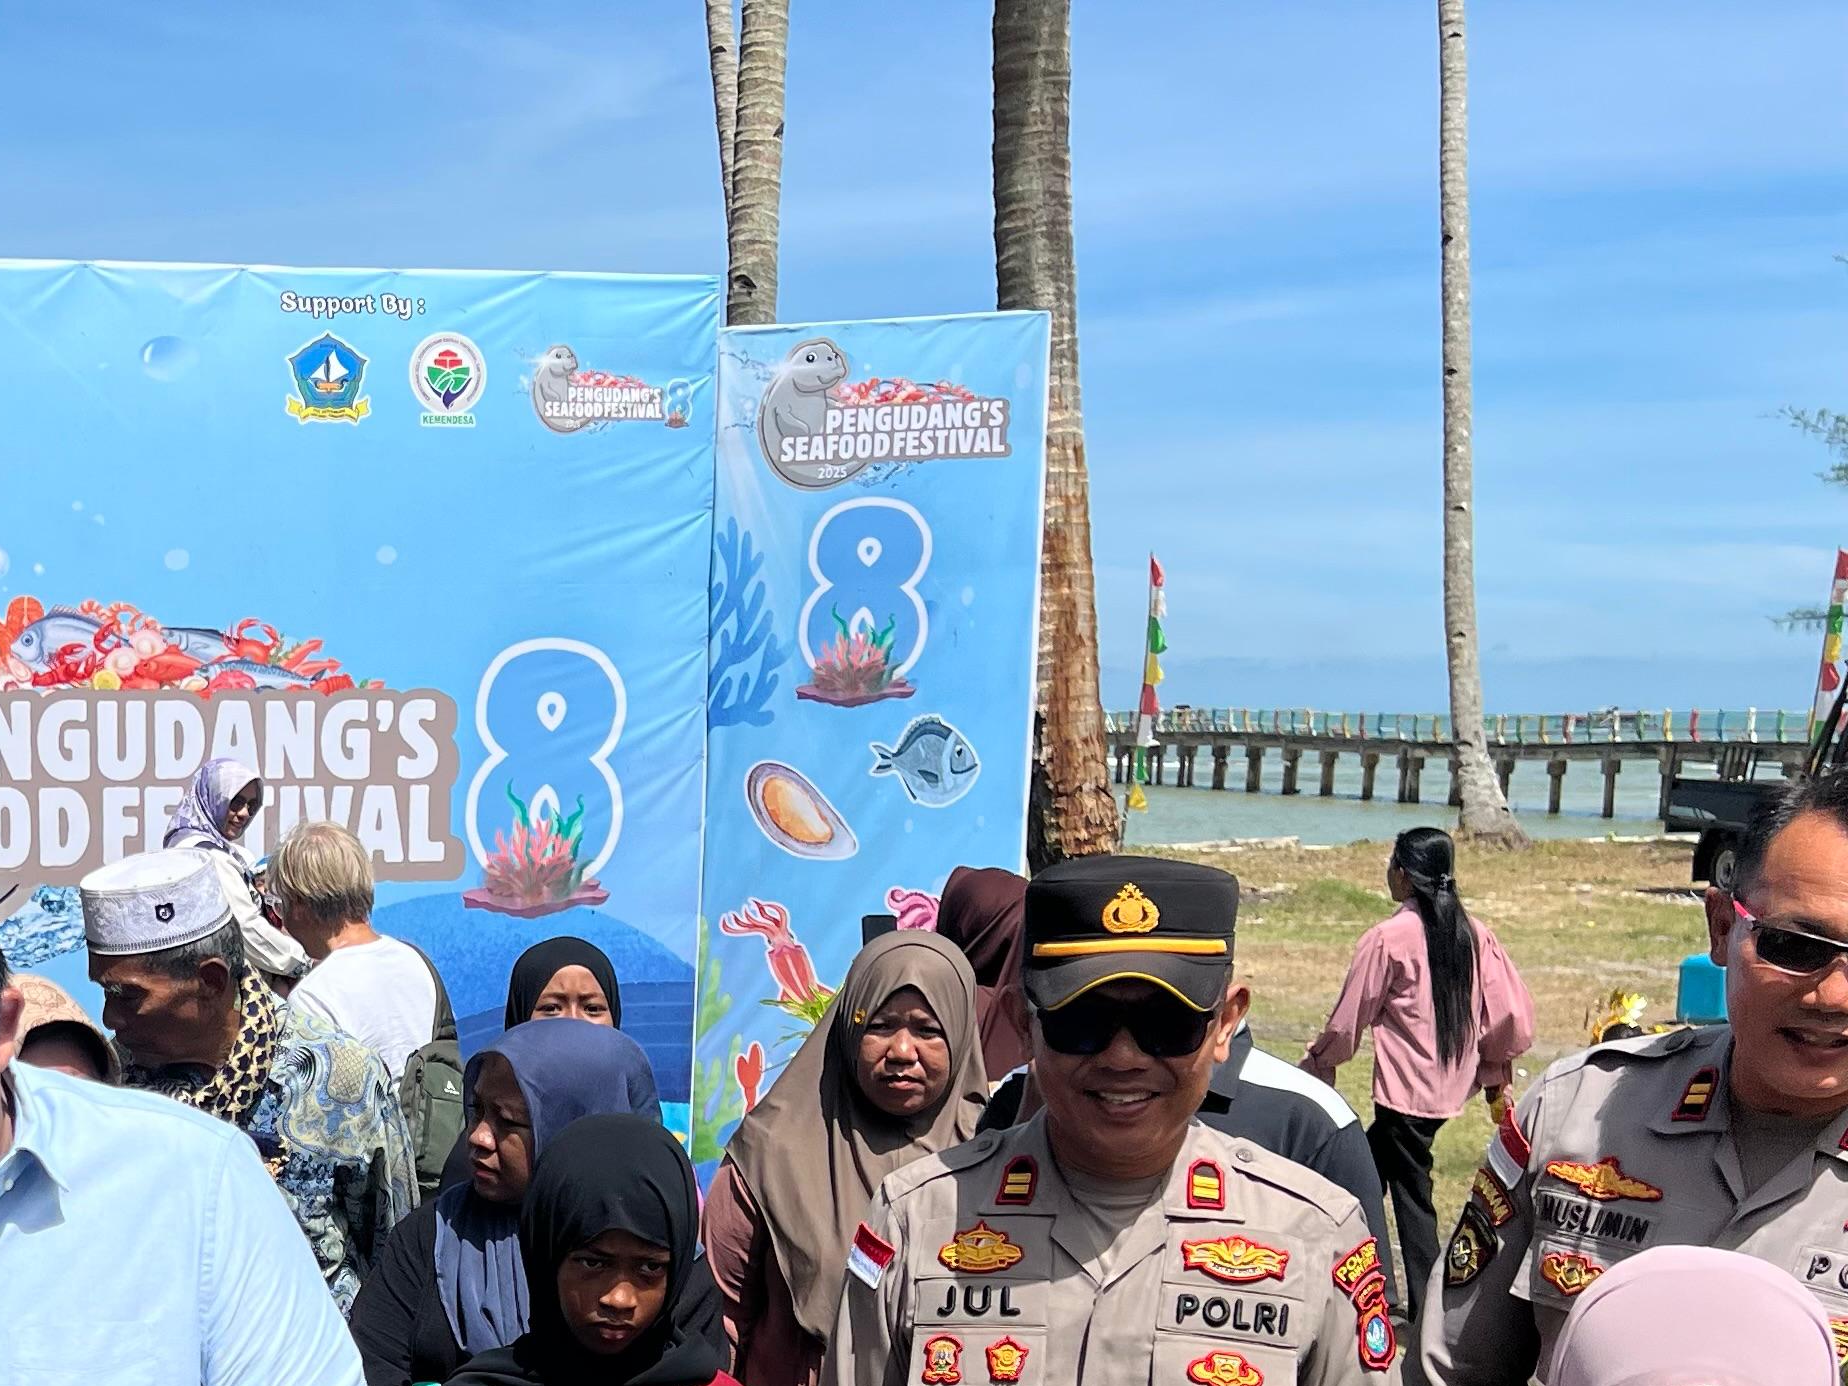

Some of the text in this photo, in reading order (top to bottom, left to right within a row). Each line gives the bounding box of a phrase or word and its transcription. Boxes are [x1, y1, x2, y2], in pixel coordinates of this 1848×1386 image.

[280, 290, 376, 319] Support
[380, 293, 413, 320] By
[544, 401, 663, 418] SEAFOOD FESTIVAL
[568, 388, 662, 403] PENGUDANG'S
[422, 415, 475, 425] KEMENDESA
[825, 400, 1004, 434] PENGUDANG'S
[780, 427, 1006, 463] SEAFOOD FESTIVAL
[817, 465, 848, 480] 2025
[936, 1285, 1021, 1317] JUL
[1176, 1293, 1289, 1337] POLRI
